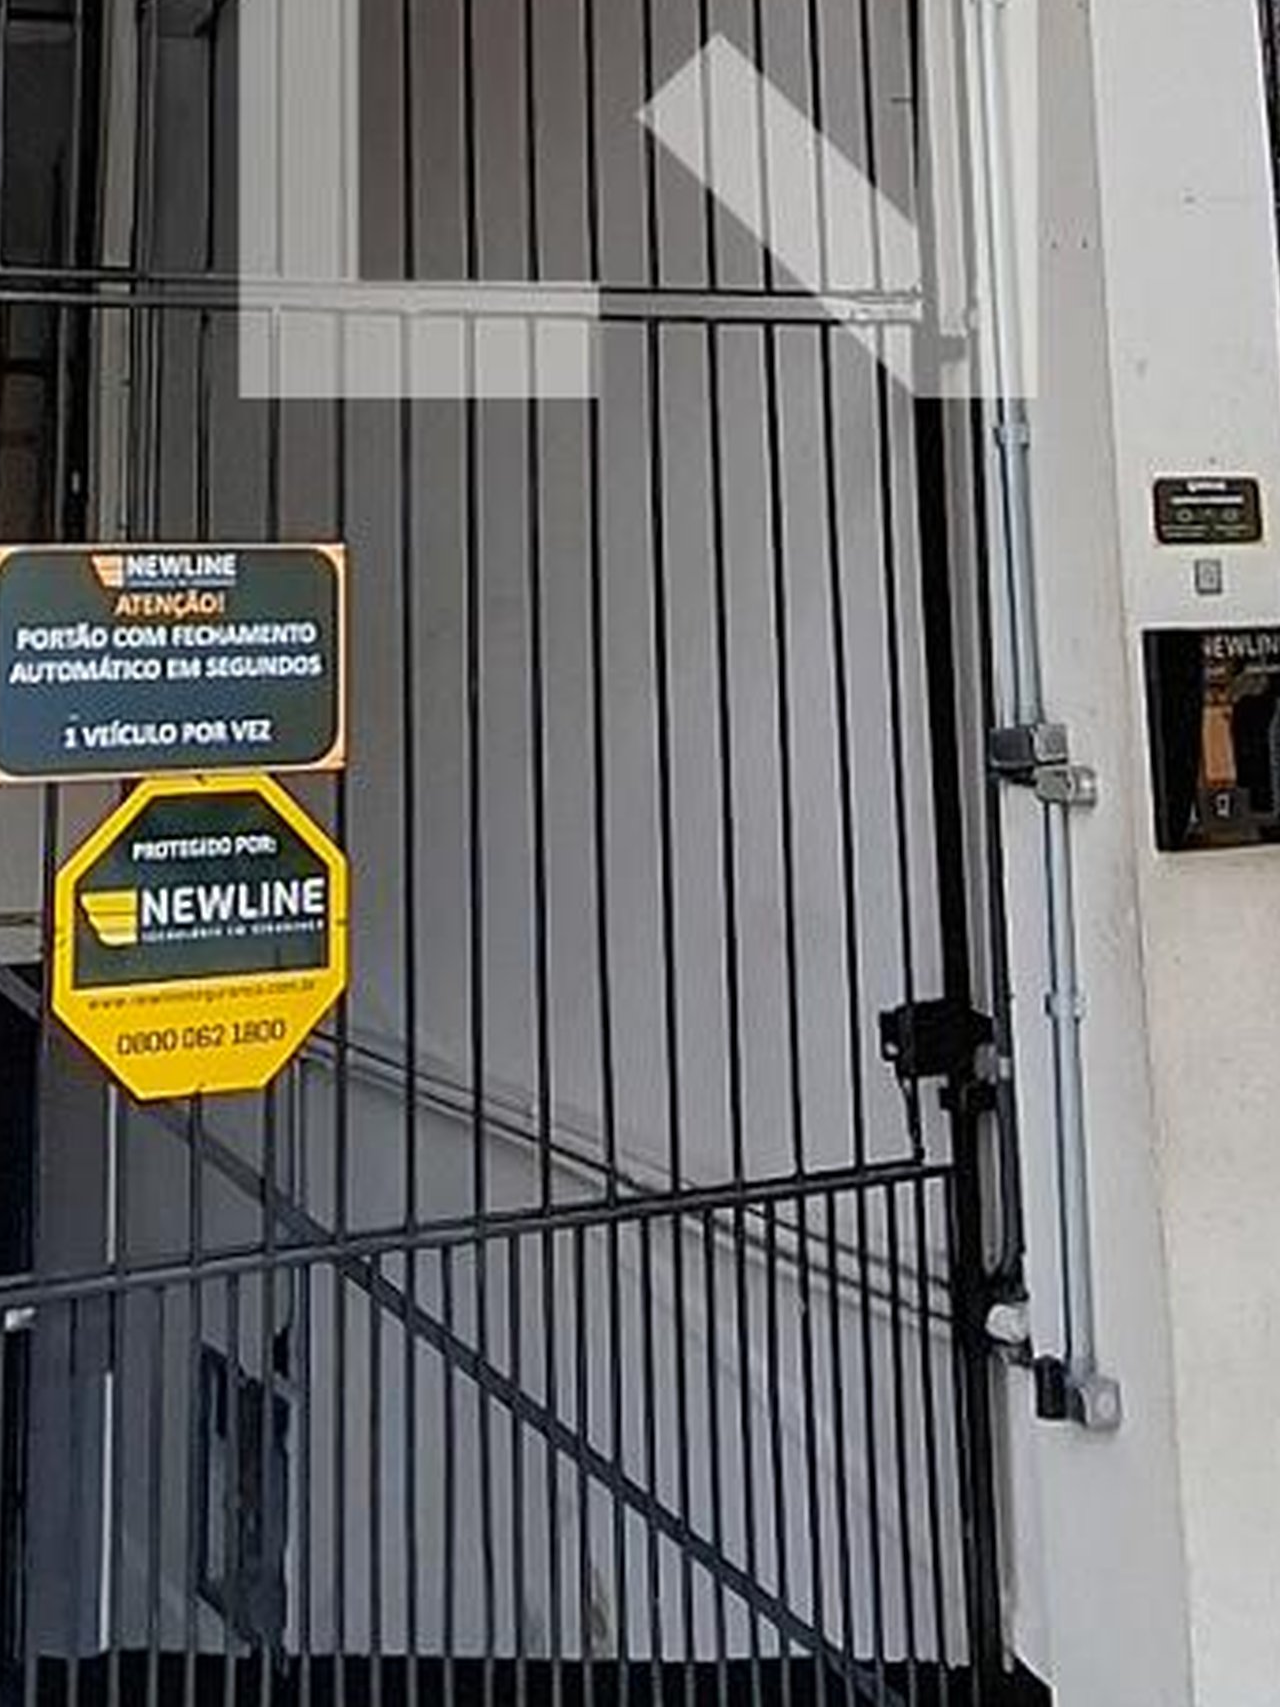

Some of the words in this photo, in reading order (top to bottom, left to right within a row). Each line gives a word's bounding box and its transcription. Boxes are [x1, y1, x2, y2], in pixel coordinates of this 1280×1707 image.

[126, 553, 237, 577] NEWLINE
[114, 589, 225, 619] ATENÇÃO!
[16, 623, 107, 650] PORTÃO
[113, 626, 166, 648] COM
[172, 622, 317, 647] FECHAMENTO
[9, 653, 161, 684] AUTOMÁTICO
[166, 658, 201, 680] EM
[205, 654, 322, 679] SEGUNDOS
[64, 727, 76, 748] 1
[82, 718, 177, 748] VEÍCULO
[181, 722, 229, 743] POR
[232, 720, 272, 742] VEZ
[132, 837, 232, 862] PROTEGIDO
[140, 877, 325, 927] NEWLINE
[117, 1029, 176, 1056] 0800
[181, 1024, 226, 1049] 062
[232, 1019, 287, 1046] 1800
